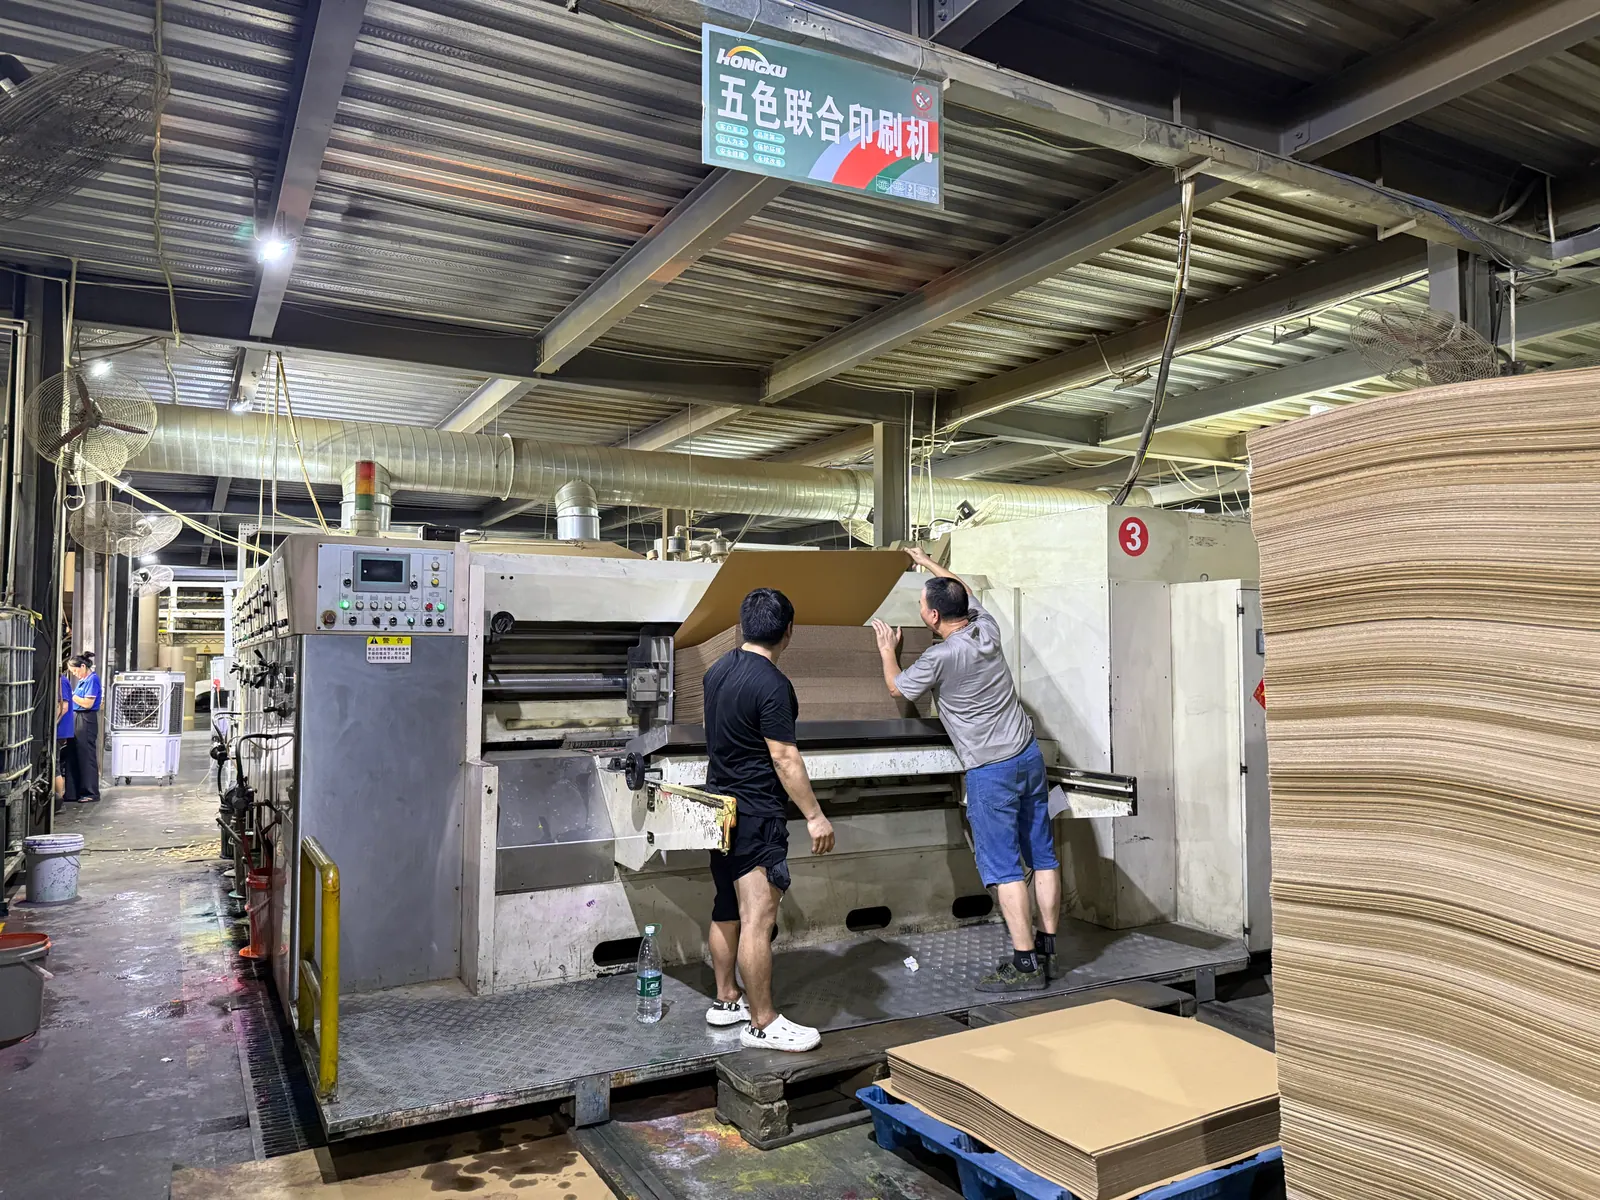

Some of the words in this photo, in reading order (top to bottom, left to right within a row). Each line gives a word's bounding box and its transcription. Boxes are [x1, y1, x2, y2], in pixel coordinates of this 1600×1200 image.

[717, 73, 933, 163] 五色联合印刷机
[719, 135, 745, 147] 以人为本
[1125, 521, 1142, 551] 3
